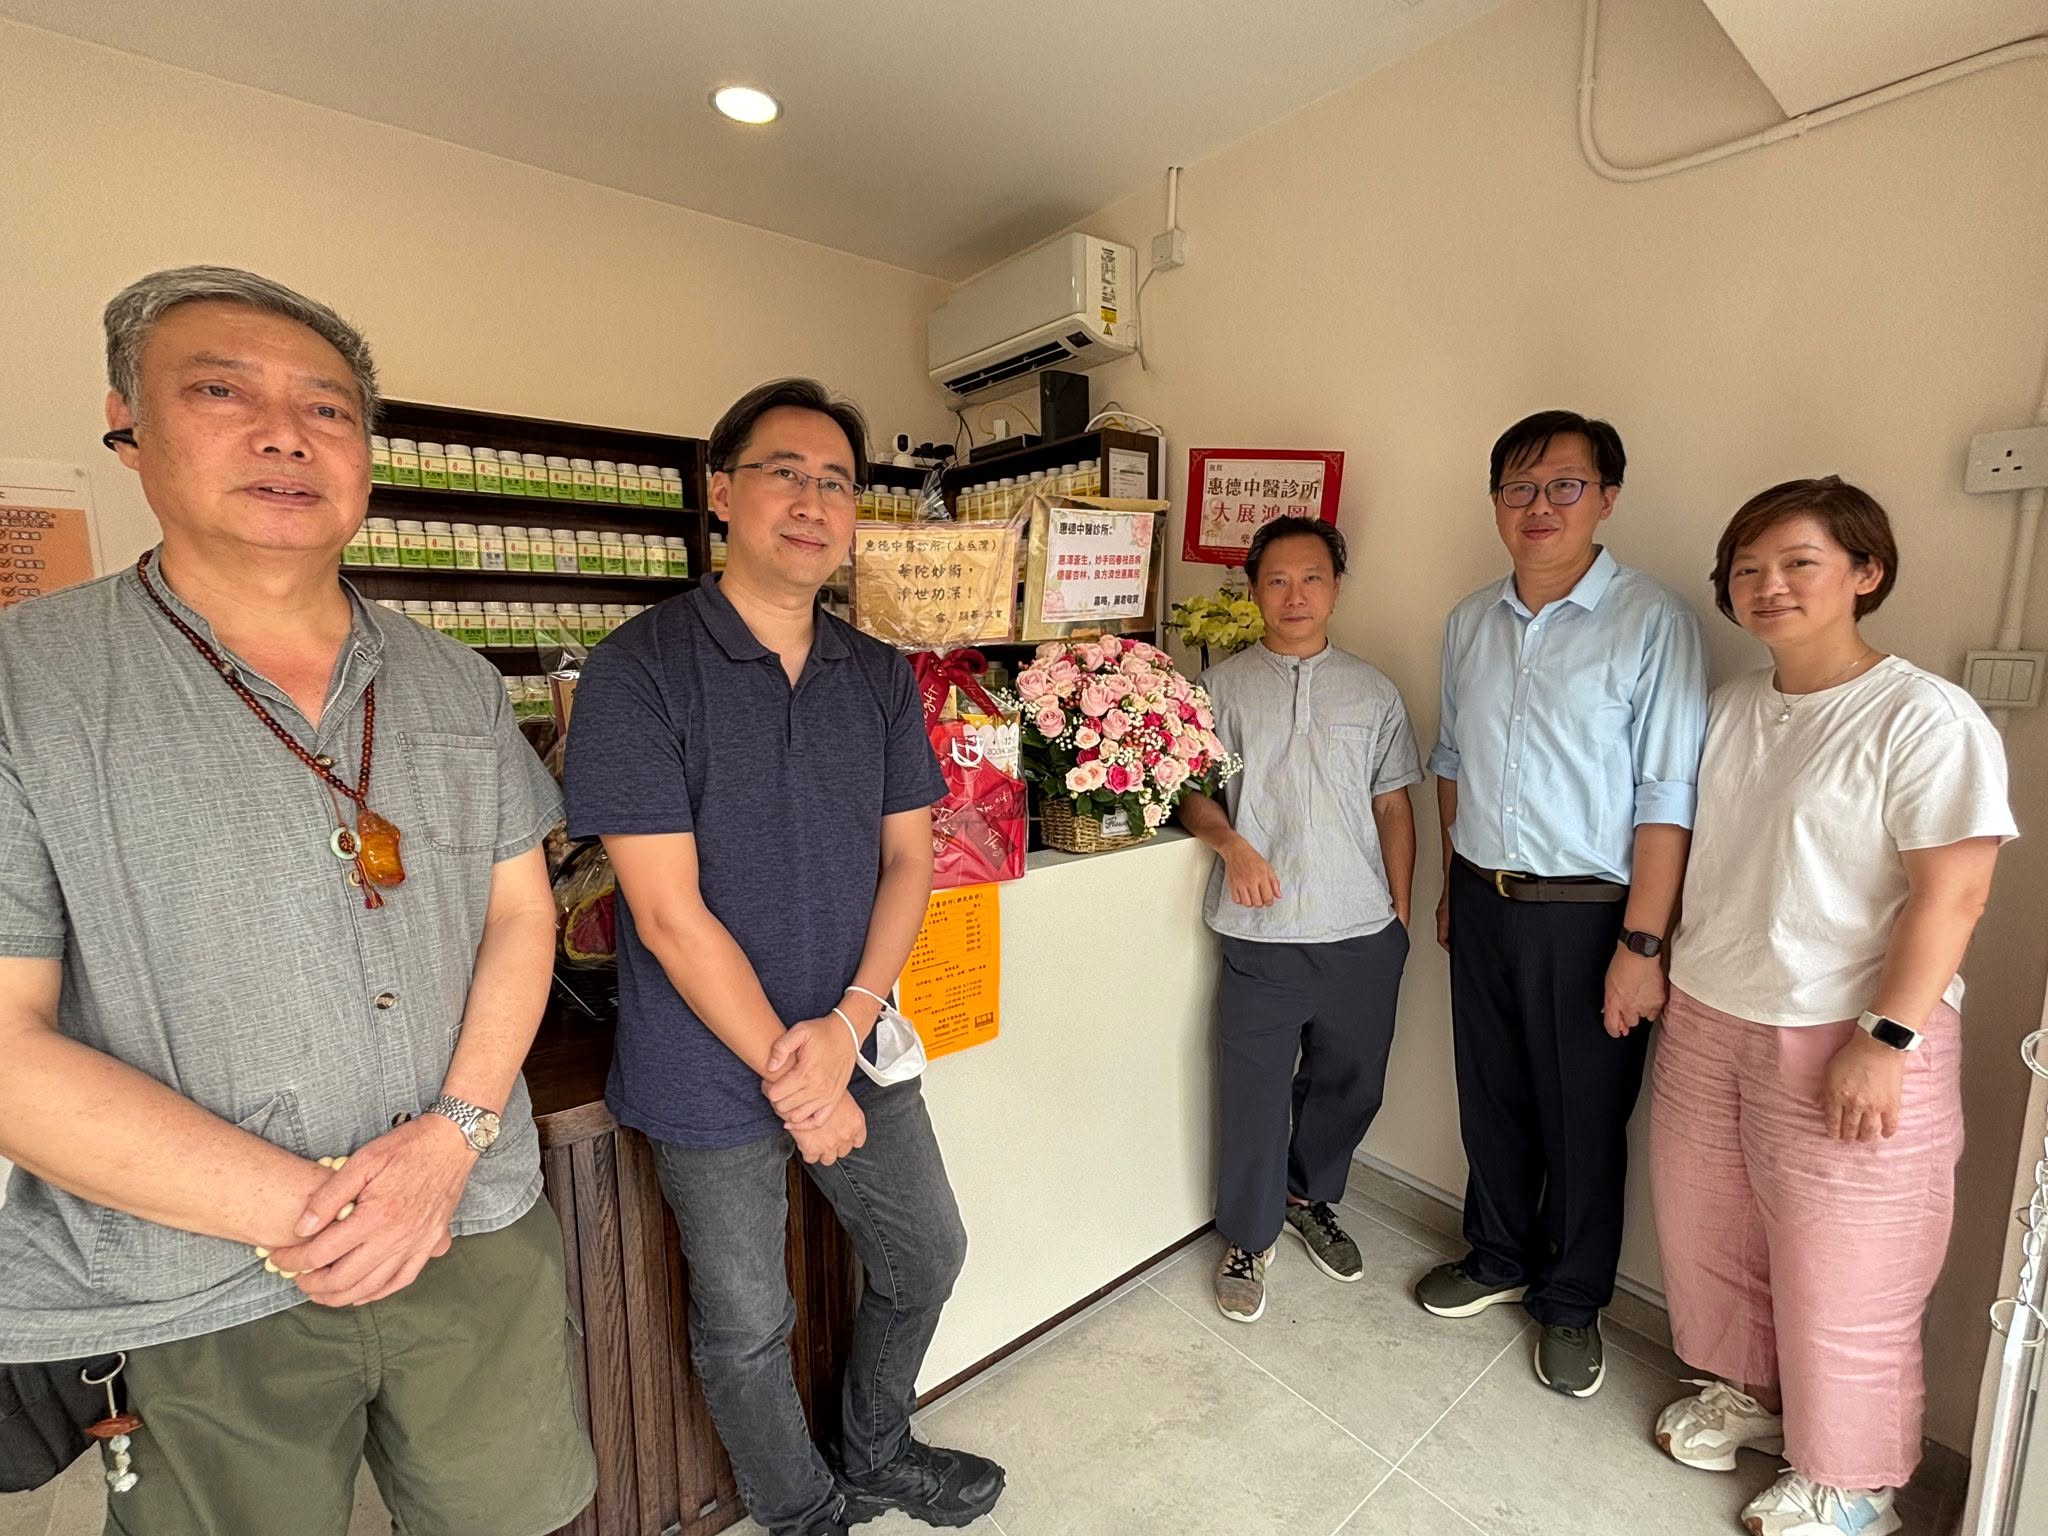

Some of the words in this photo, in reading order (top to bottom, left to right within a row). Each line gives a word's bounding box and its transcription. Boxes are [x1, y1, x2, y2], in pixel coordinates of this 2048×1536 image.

[1207, 477, 1320, 500] 惠德中醫診所
